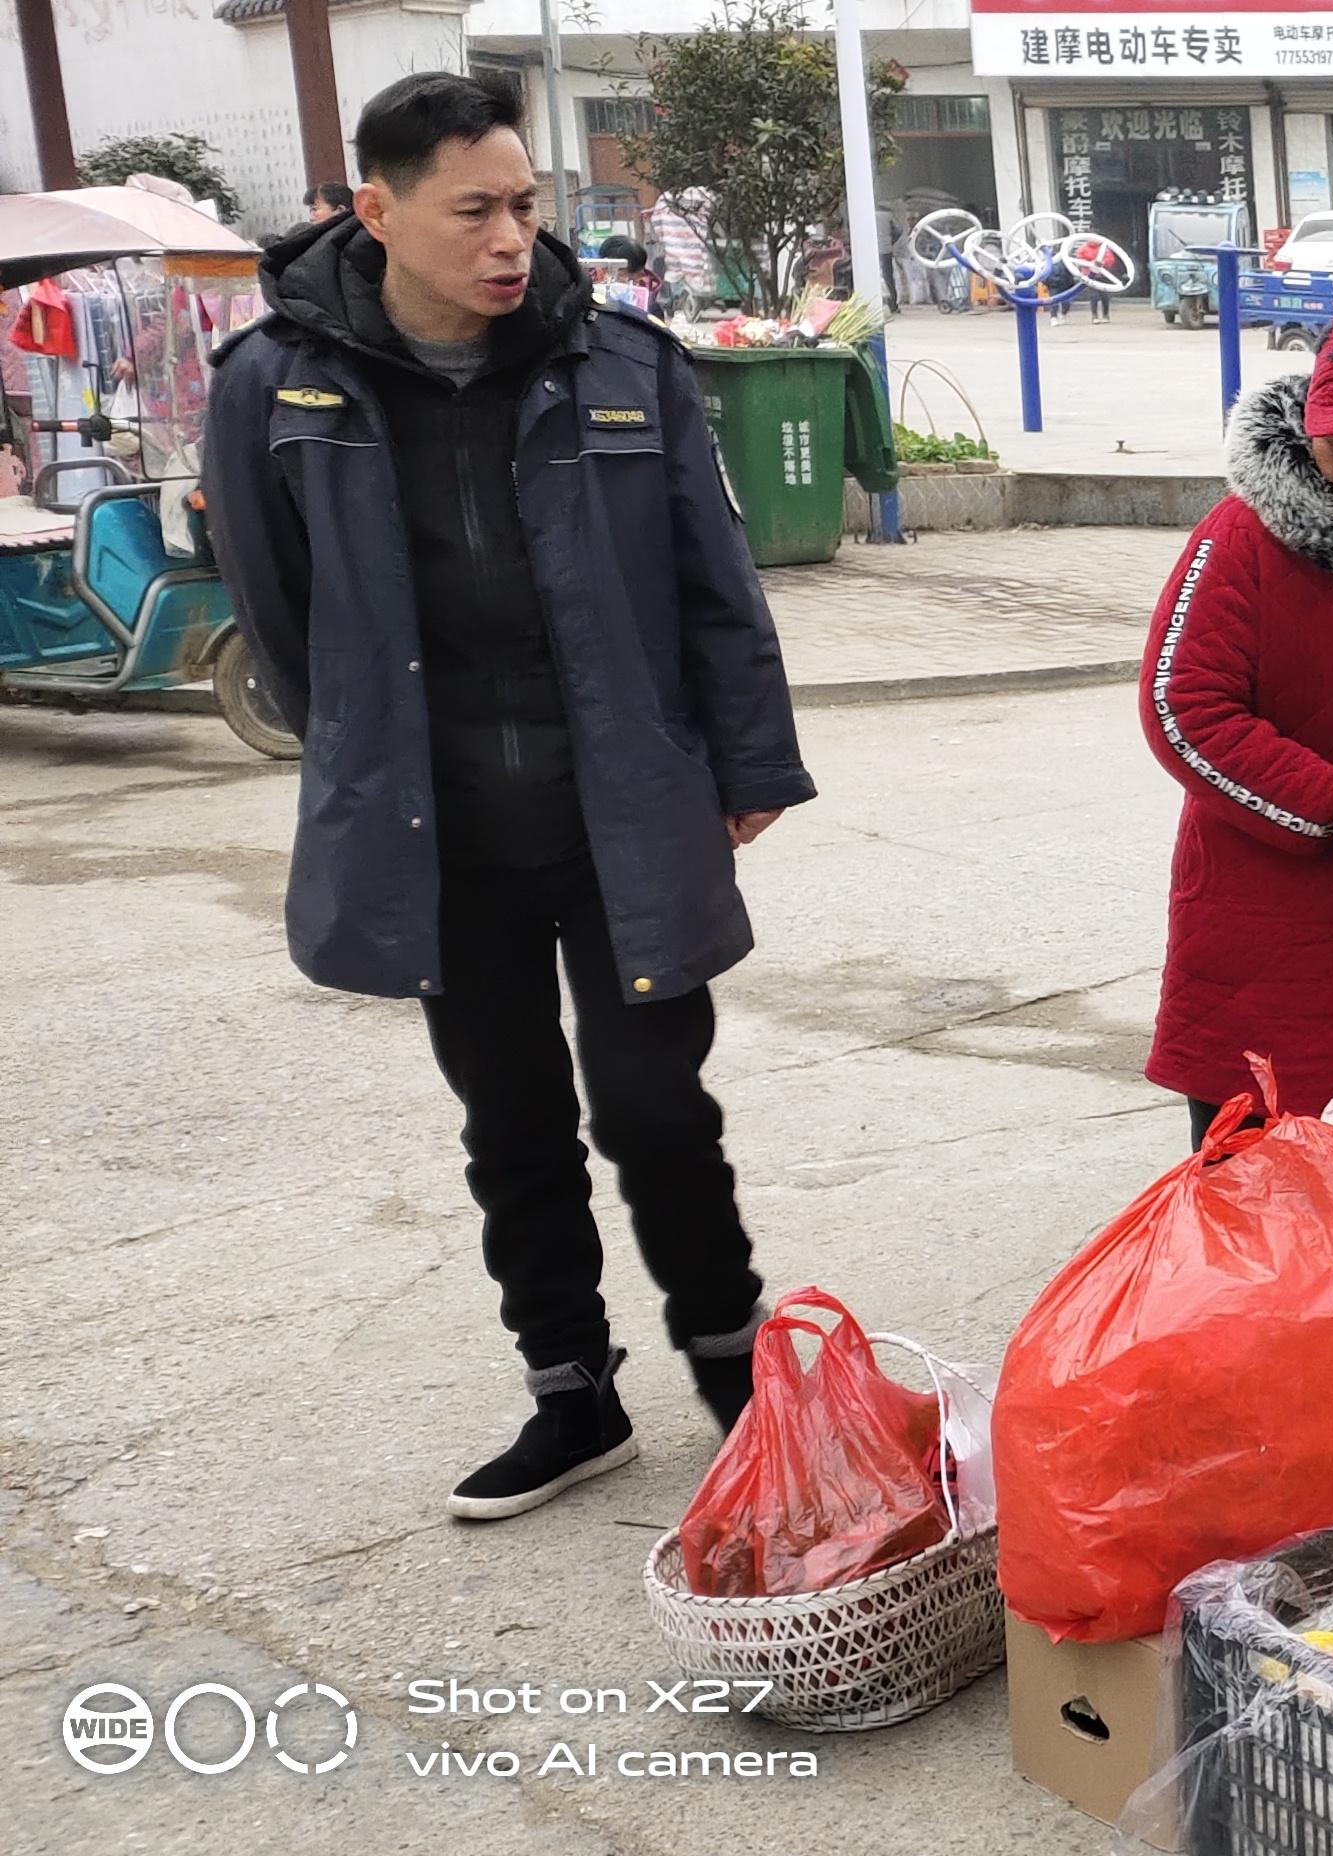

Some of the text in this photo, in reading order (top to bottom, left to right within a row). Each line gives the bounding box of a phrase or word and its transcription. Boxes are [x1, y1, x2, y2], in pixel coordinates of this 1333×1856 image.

[1020, 25, 1243, 65] 建摩电动车专卖
[1101, 109, 1204, 141] 欢迎光临
